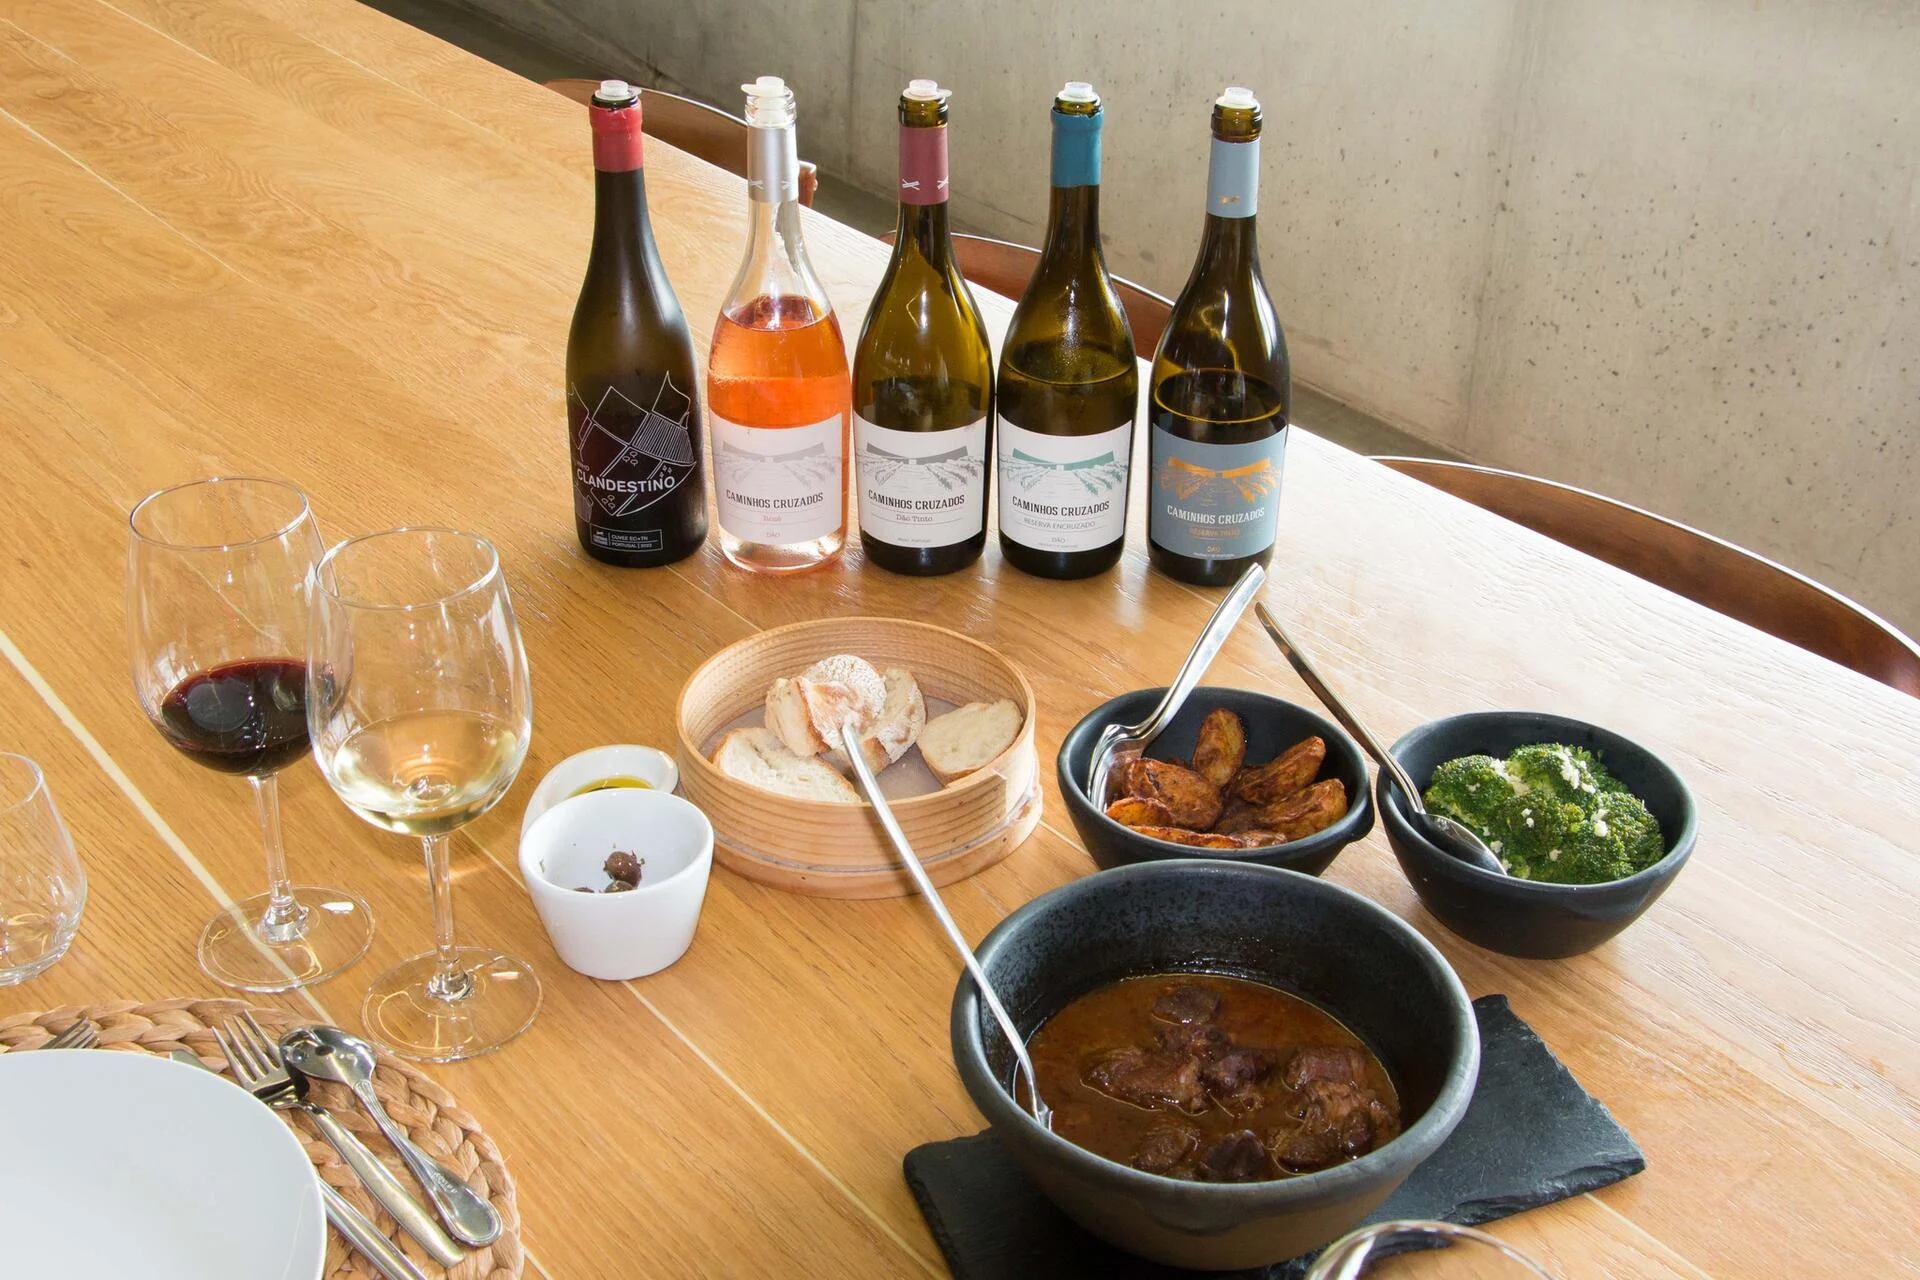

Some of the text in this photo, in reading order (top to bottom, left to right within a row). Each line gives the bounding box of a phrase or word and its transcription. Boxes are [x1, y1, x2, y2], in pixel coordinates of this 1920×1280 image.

[577, 468, 675, 493] CLANDESTINO
[726, 488, 824, 509] CAMINHOS CRUZADOS
[868, 489, 965, 511] CAMINHOS CRUZADOS
[1012, 495, 1110, 517] CAMINHOS CRUZADOS
[912, 515, 933, 523] Tinto
[1023, 517, 1096, 530] RESERVA ENCRUZADO
[1167, 504, 1265, 525] CAMINHOS CRUZADOS
